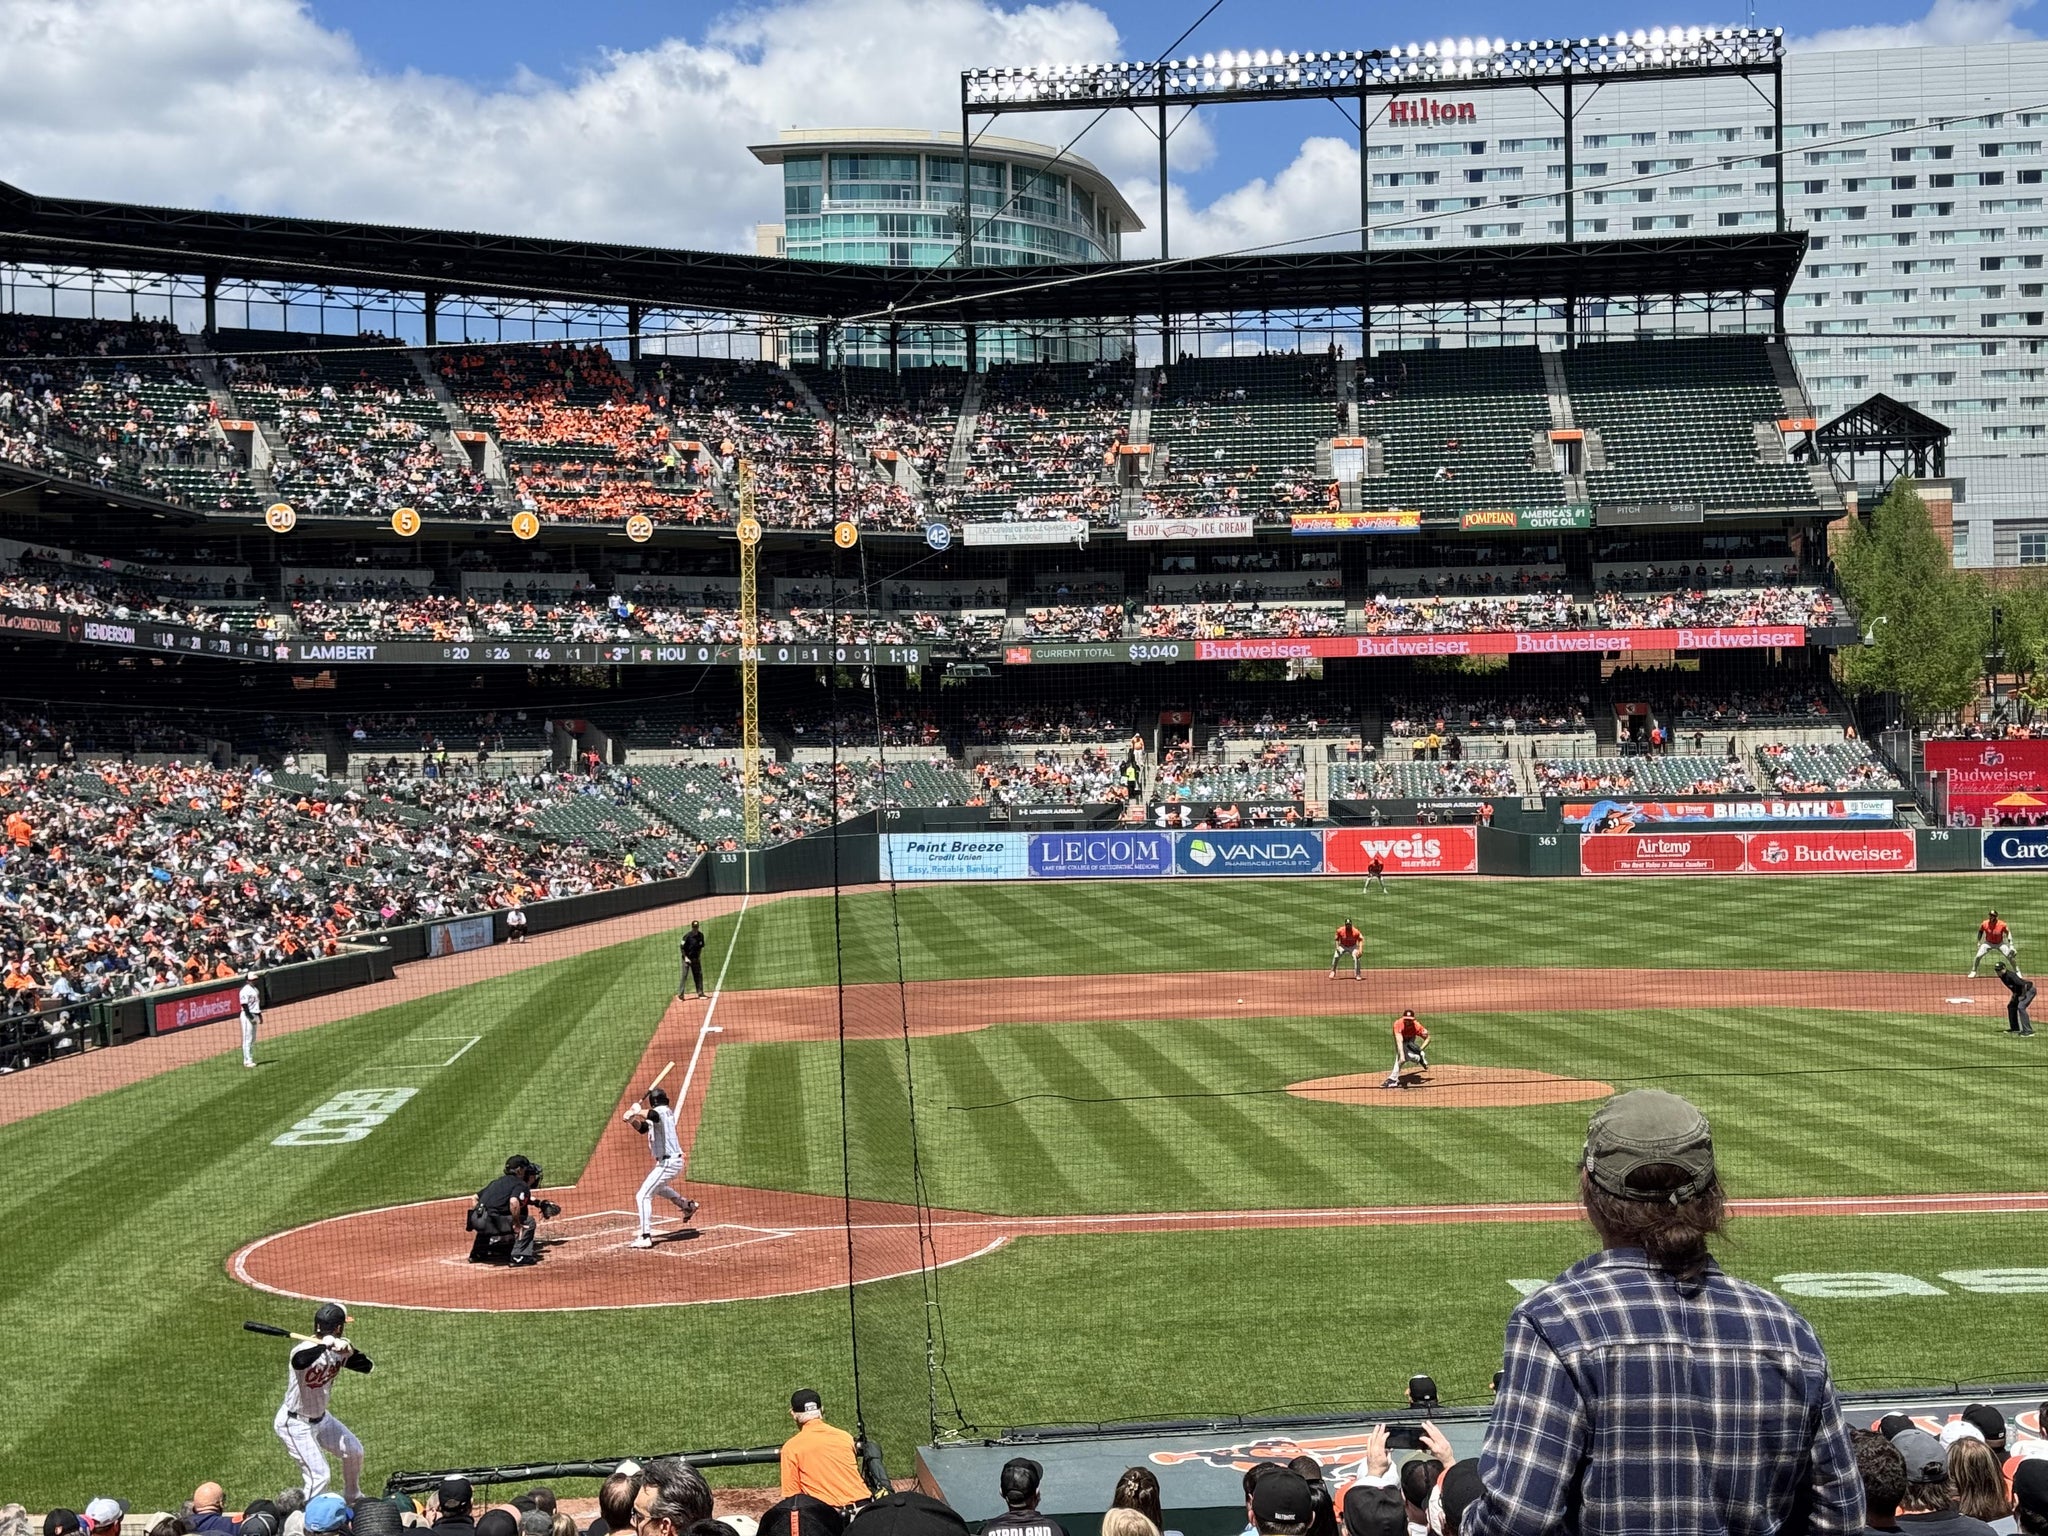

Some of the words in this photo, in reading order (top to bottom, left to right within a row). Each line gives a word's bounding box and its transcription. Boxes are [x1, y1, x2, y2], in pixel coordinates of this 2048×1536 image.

[1389, 97, 1477, 124] Hilton
[271, 509, 292, 526] 20
[1465, 511, 1514, 525] POMPEIAN
[1521, 509, 1572, 519] AMERICA'S
[1575, 509, 1585, 518] #1
[401, 514, 411, 531] 5
[520, 518, 529, 534] 4
[631, 522, 648, 536] 22
[1133, 525, 1159, 536] ENJOY
[1201, 523, 1215, 534] ICE
[1219, 522, 1247, 534] CREAM
[1293, 518, 1332, 530] Surfside
[1357, 517, 1396, 529] Surfside
[1530, 518, 1559, 527] OLIVE
[1560, 518, 1577, 526] OIL
[841, 525, 850, 541] 8
[929, 528, 947, 544] 42
[84, 622, 135, 644] HENDERSON
[301, 646, 376, 660] LAMBERT
[443, 649, 450, 658] B
[452, 648, 470, 660] 20
[485, 649, 492, 658] S
[493, 648, 511, 660] 26
[527, 649, 533, 658] T
[534, 648, 551, 660] 46
[566, 649, 573, 658] K
[657, 648, 686, 661] HOU
[698, 648, 708, 661] 0
[778, 649, 788, 661] 0
[802, 651, 808, 659] B
[811, 649, 818, 662] 1
[836, 649, 846, 662] 0
[863, 649, 870, 662] 1
[889, 649, 919, 662] 1:18
[1036, 649, 1081, 658] CURRENT
[1083, 648, 1115, 658] TOTAL
[1129, 645, 1179, 660] $3,040
[1945, 767, 2036, 782] Budweiser
[1685, 805, 1706, 813] Tower
[1713, 803, 1766, 818] BIRD
[1771, 802, 1828, 817] BATH
[1860, 801, 1884, 809] Tower
[1538, 837, 1557, 846] 363
[1930, 831, 1949, 841] 376
[907, 841, 947, 852] Point
[951, 841, 1004, 852] Breeze
[1217, 844, 1310, 860] VANDA
[1360, 833, 1441, 859] weis
[1637, 839, 1691, 856] Airtemp
[720, 854, 737, 863] 333
[957, 853, 982, 861] Union
[1401, 859, 1441, 867] markets
[931, 865, 964, 873] Reliable
[190, 998, 231, 1020] Budweiser
